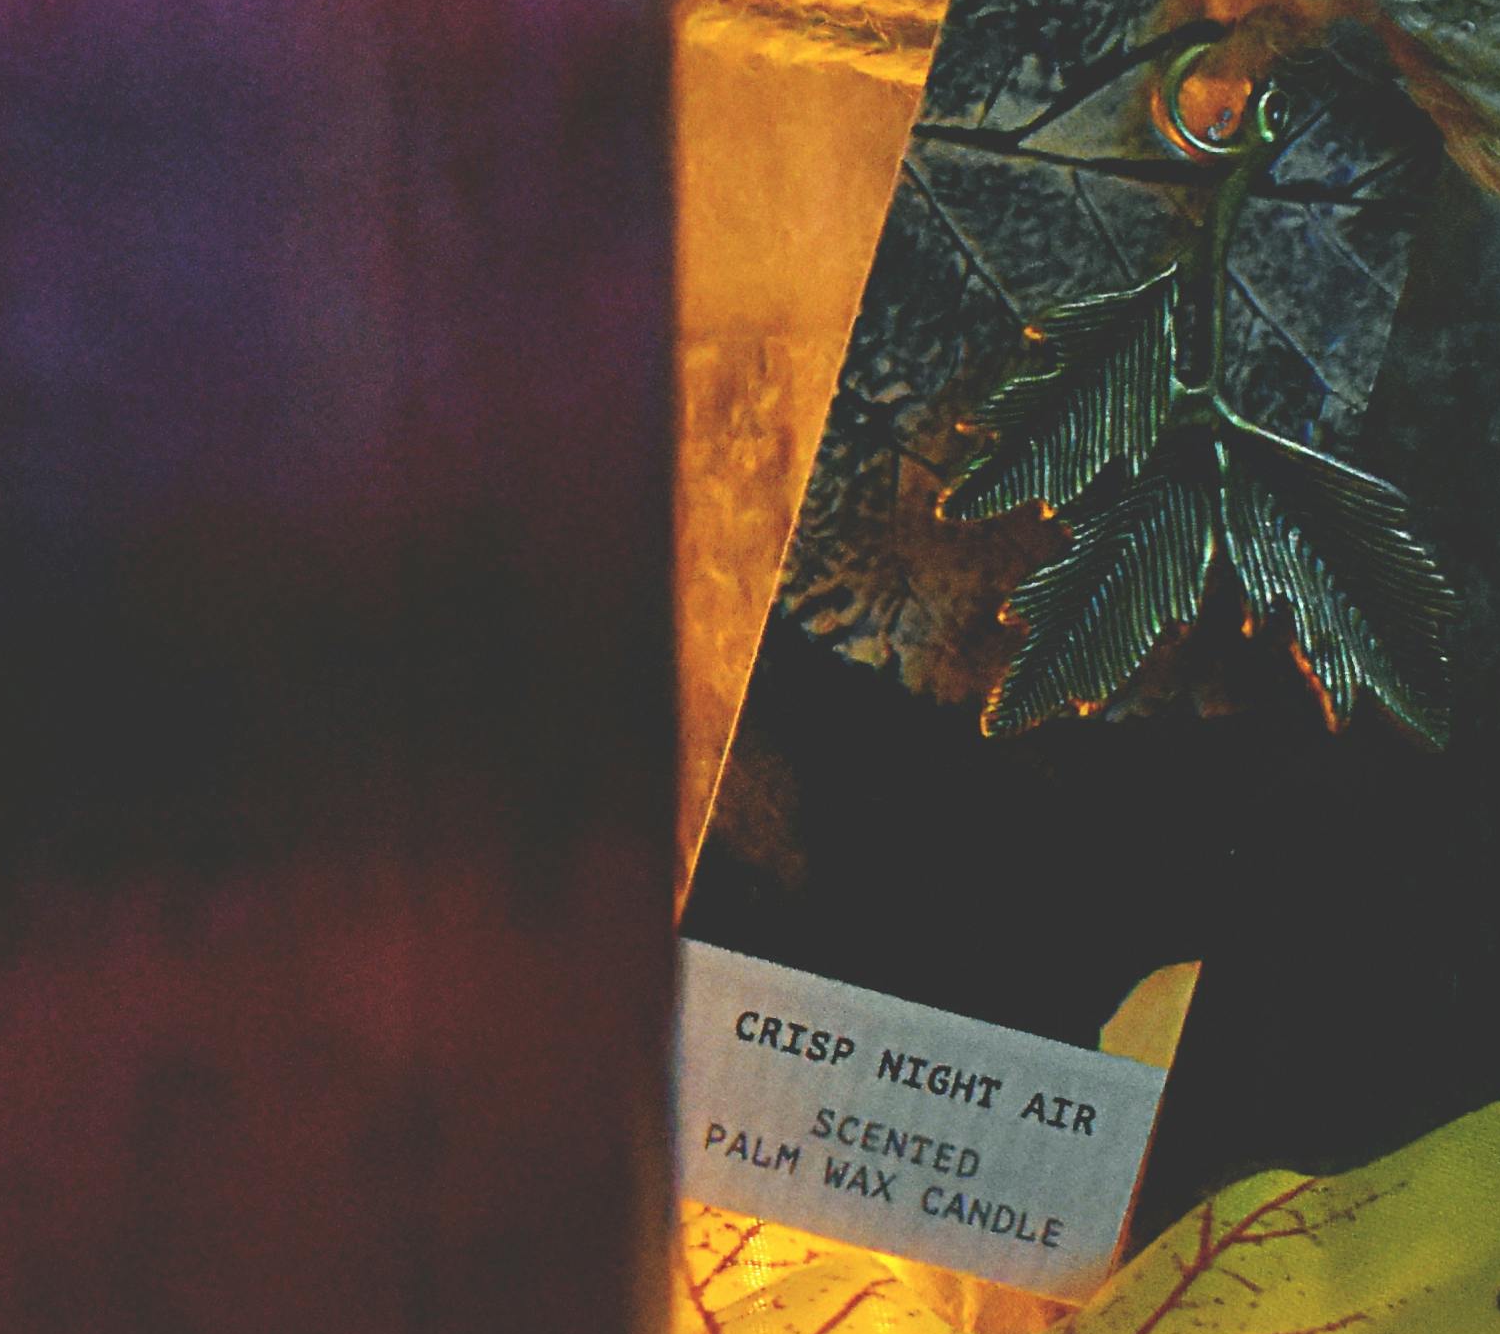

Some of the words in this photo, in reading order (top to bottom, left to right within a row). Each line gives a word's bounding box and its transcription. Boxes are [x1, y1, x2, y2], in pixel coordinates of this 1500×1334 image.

[735, 1011, 855, 1063] CRISP
[877, 1049, 1002, 1109] NIGHT
[1020, 1091, 1097, 1136] AIR
[705, 1122, 801, 1175] PALM
[823, 1156, 897, 1202] WAX
[921, 1186, 1064, 1248] CANDLE
[810, 1107, 981, 1179] SCENTED
